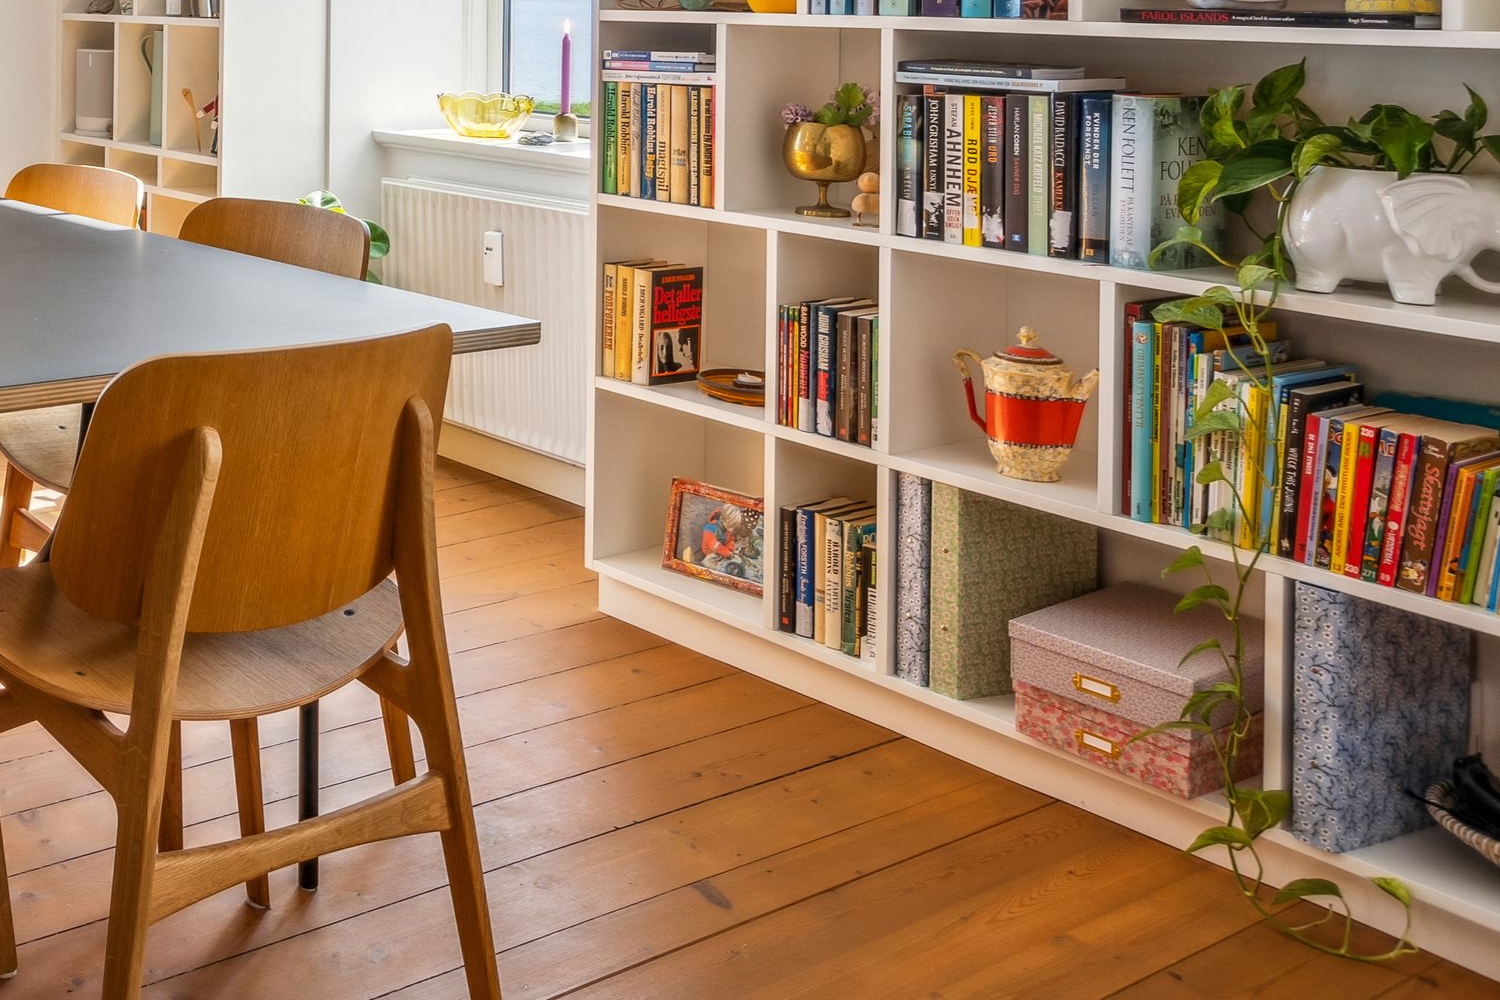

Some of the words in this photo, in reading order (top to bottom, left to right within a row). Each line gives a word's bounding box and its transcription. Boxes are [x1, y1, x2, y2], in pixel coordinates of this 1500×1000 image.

[606, 87, 616, 116] Harold
[620, 89, 630, 118] Harold
[647, 86, 656, 116] Harold
[928, 98, 939, 123] JOHN
[1055, 101, 1065, 128] DAVID
[903, 105, 912, 128] SARA
[950, 102, 958, 128] STEFAN
[988, 105, 997, 126] JESPER
[1032, 113, 1043, 144] MICHAEL
[1122, 107, 1136, 134] KEN
[606, 118, 615, 152] Robbins
[620, 120, 630, 155] Robbins
[646, 117, 656, 153] Robbins
[988, 127, 997, 143] STEIN
[1084, 115, 1092, 165] FORSVANDT
[1093, 112, 1101, 150] KVINDEN
[928, 123, 939, 167] GRISHAM
[967, 138, 978, 164] RØD
[987, 145, 997, 163] URO
[1032, 145, 1043, 162] KATZ
[1054, 128, 1065, 167] BALDACCI
[1177, 136, 1208, 157] KEN
[644, 154, 656, 180] Betsy
[657, 141, 668, 192] magtspil
[946, 128, 962, 207] AHNHEM
[1092, 152, 1100, 169] DER
[1120, 138, 1136, 193] FOLLETT
[929, 169, 937, 192] USKYL
[1032, 163, 1043, 193] KREFELD
[946, 208, 960, 216] OFFER
[1160, 193, 1171, 206] PÅ
[653, 286, 676, 306] Det
[676, 283, 702, 304] aller
[604, 289, 614, 351] FORFØREREN
[653, 304, 701, 326] helligste
[800, 305, 808, 326] BARI
[818, 311, 829, 334] JOHN
[800, 326, 808, 349] WOOD
[817, 334, 829, 370] GRISHAM
[1137, 348, 1145, 385] GRIMMS
[1135, 387, 1144, 429] EVENTYR
[1360, 428, 1375, 438] 230
[1288, 447, 1298, 471] WRECK
[1286, 471, 1296, 487] THIS
[1335, 530, 1343, 557] ANDERS
[798, 545, 808, 578] FORSYTH
[831, 541, 840, 575] HAROLD
[843, 551, 855, 588] Robbins
[1344, 563, 1359, 574] 230
[1361, 568, 1375, 578] 271
[1379, 572, 1391, 582] 89
[843, 588, 854, 623] Piraten
